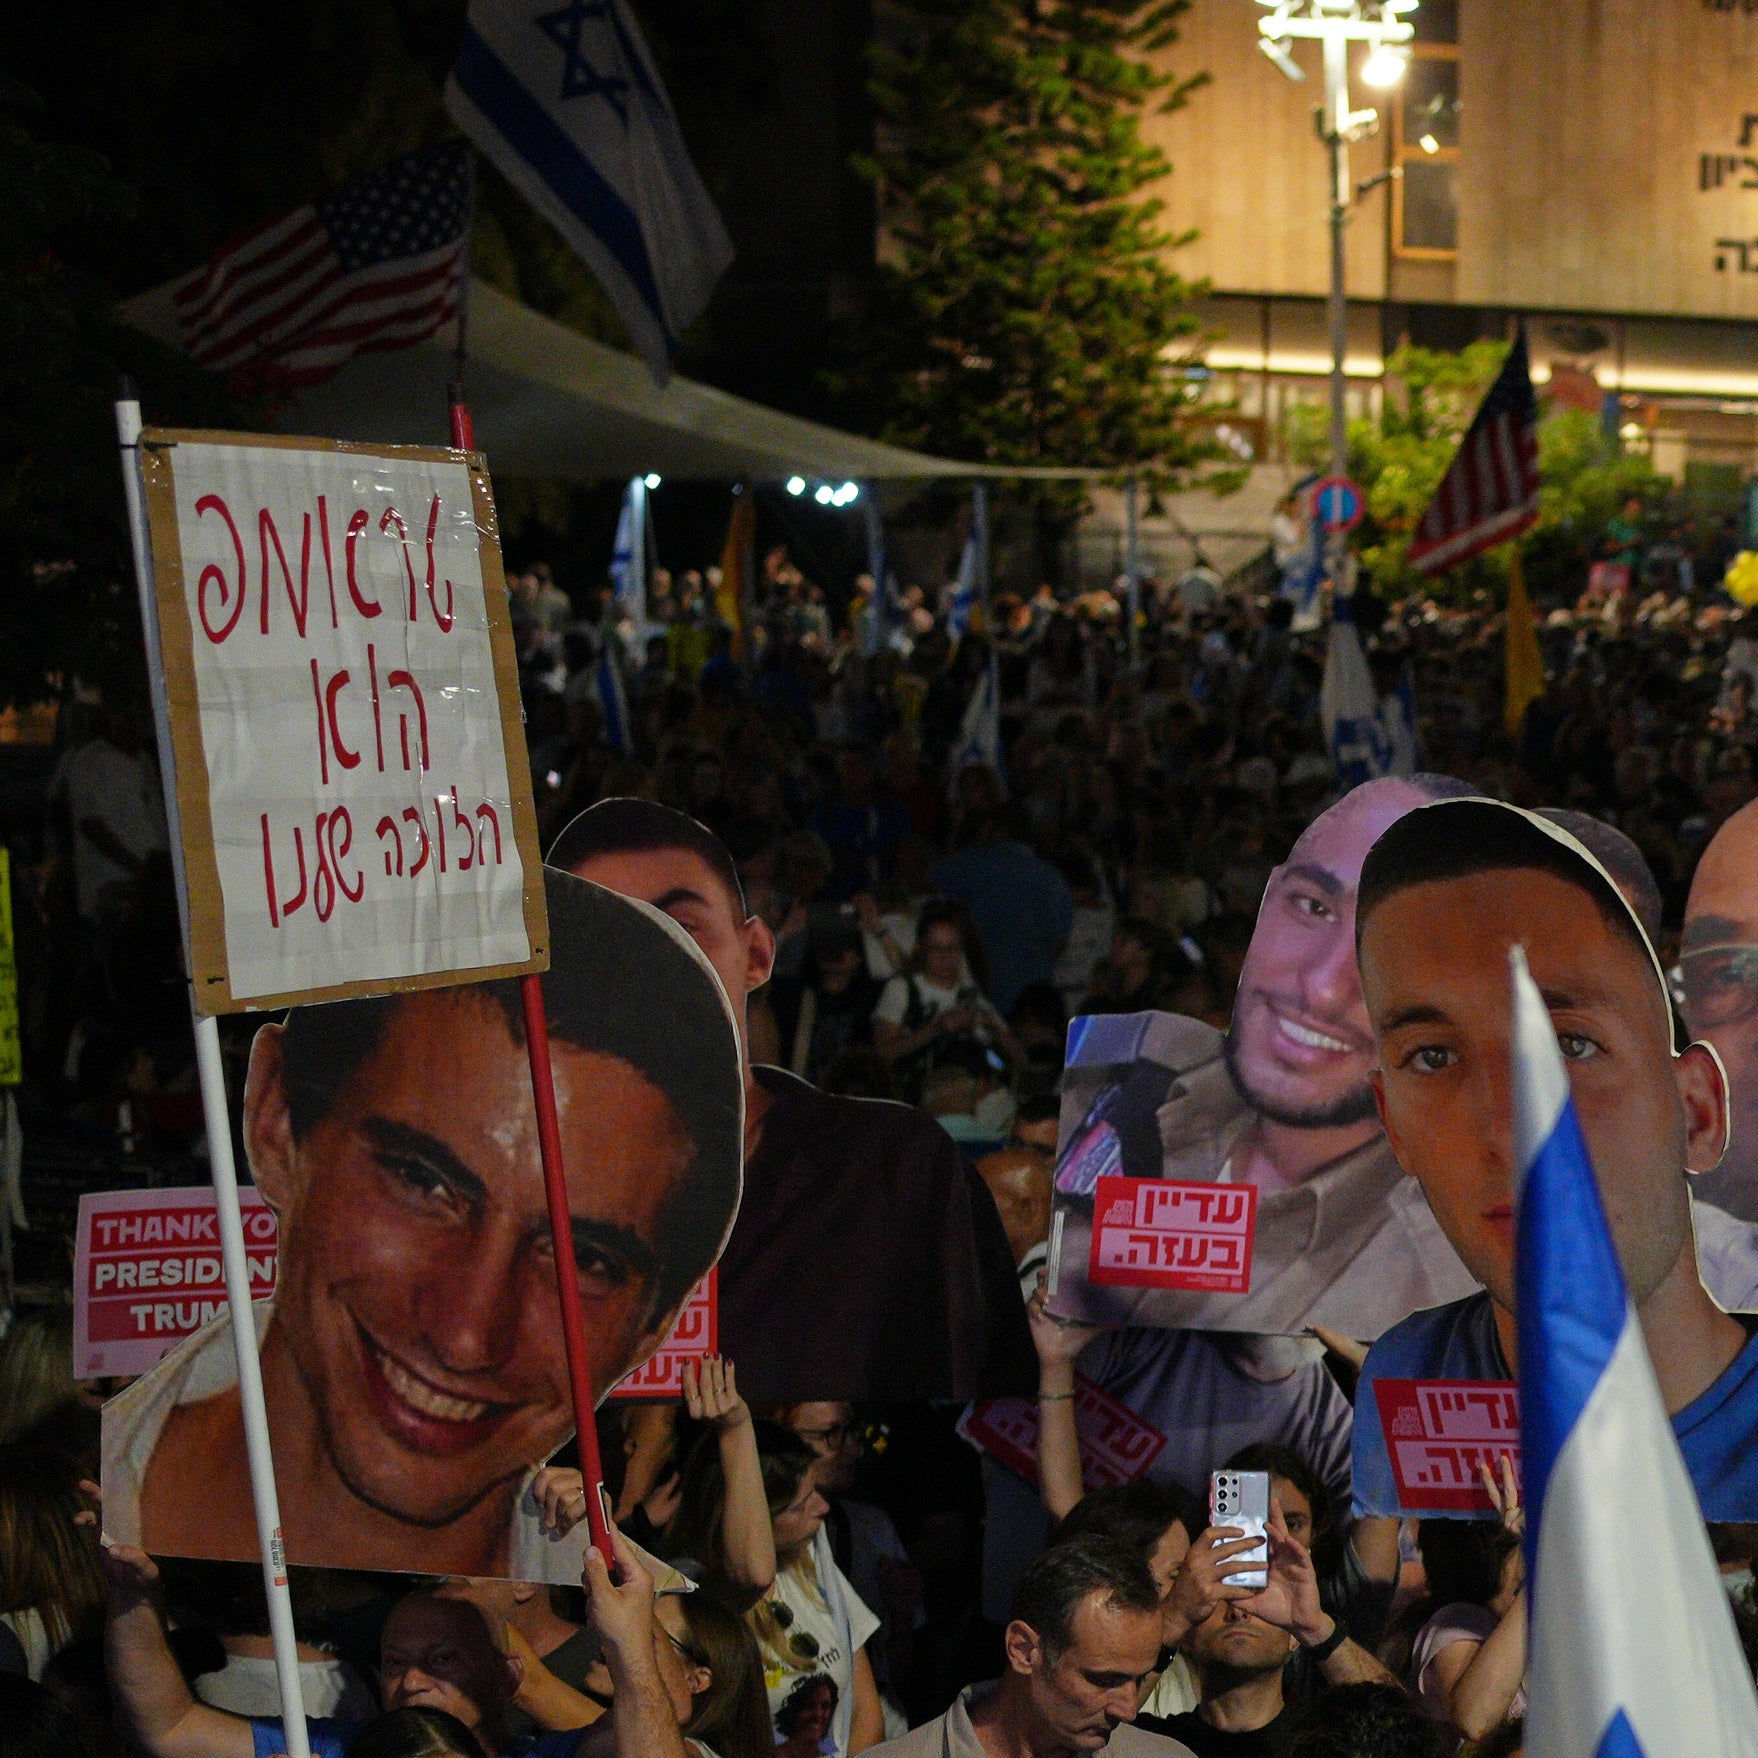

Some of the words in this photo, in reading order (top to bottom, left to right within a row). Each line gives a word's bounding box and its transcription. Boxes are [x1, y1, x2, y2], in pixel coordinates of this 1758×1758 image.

[310, 643, 431, 785] הוא
[1143, 1189, 1244, 1225] עדיין
[96, 1213, 217, 1246] THANK
[95, 1255, 278, 1290] PRESIDN
[129, 1300, 231, 1332] TRUM
